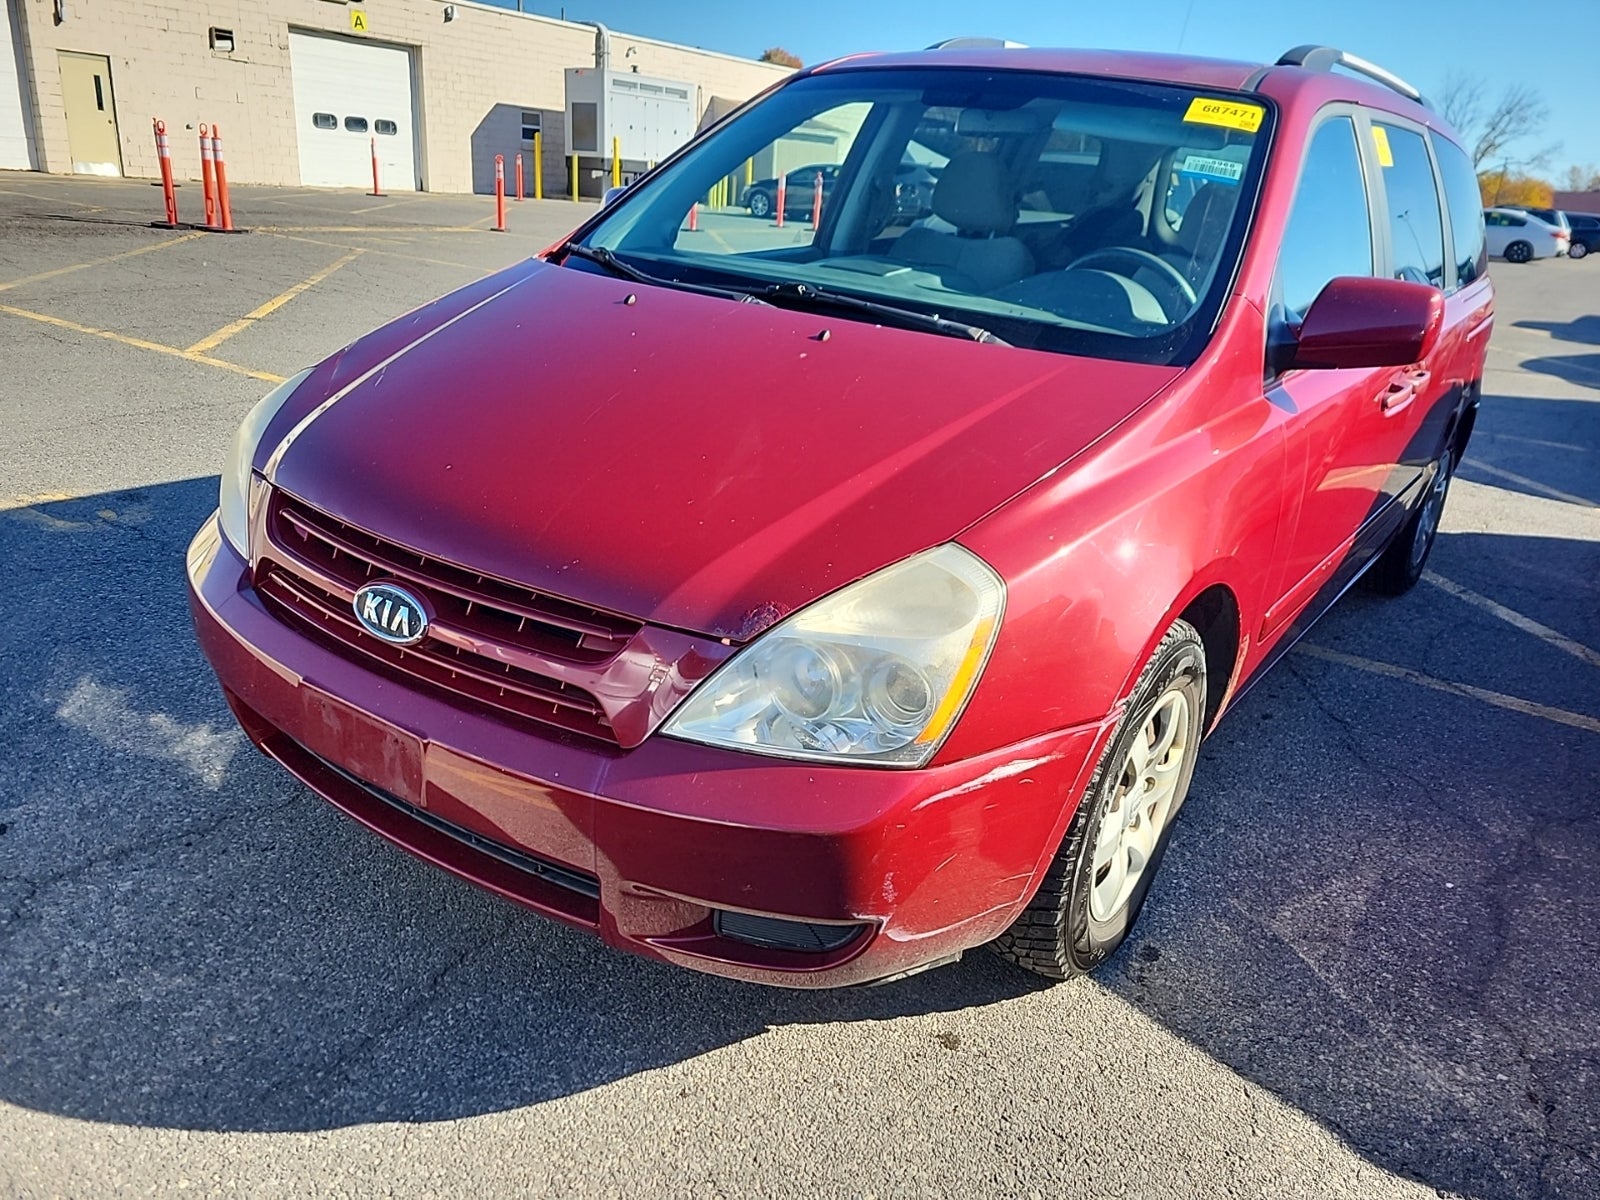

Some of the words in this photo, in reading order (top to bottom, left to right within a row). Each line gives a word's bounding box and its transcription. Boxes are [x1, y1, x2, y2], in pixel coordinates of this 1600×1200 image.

[354, 15, 364, 29] A
[1202, 104, 1256, 120] 687471
[363, 592, 410, 637] KIA
